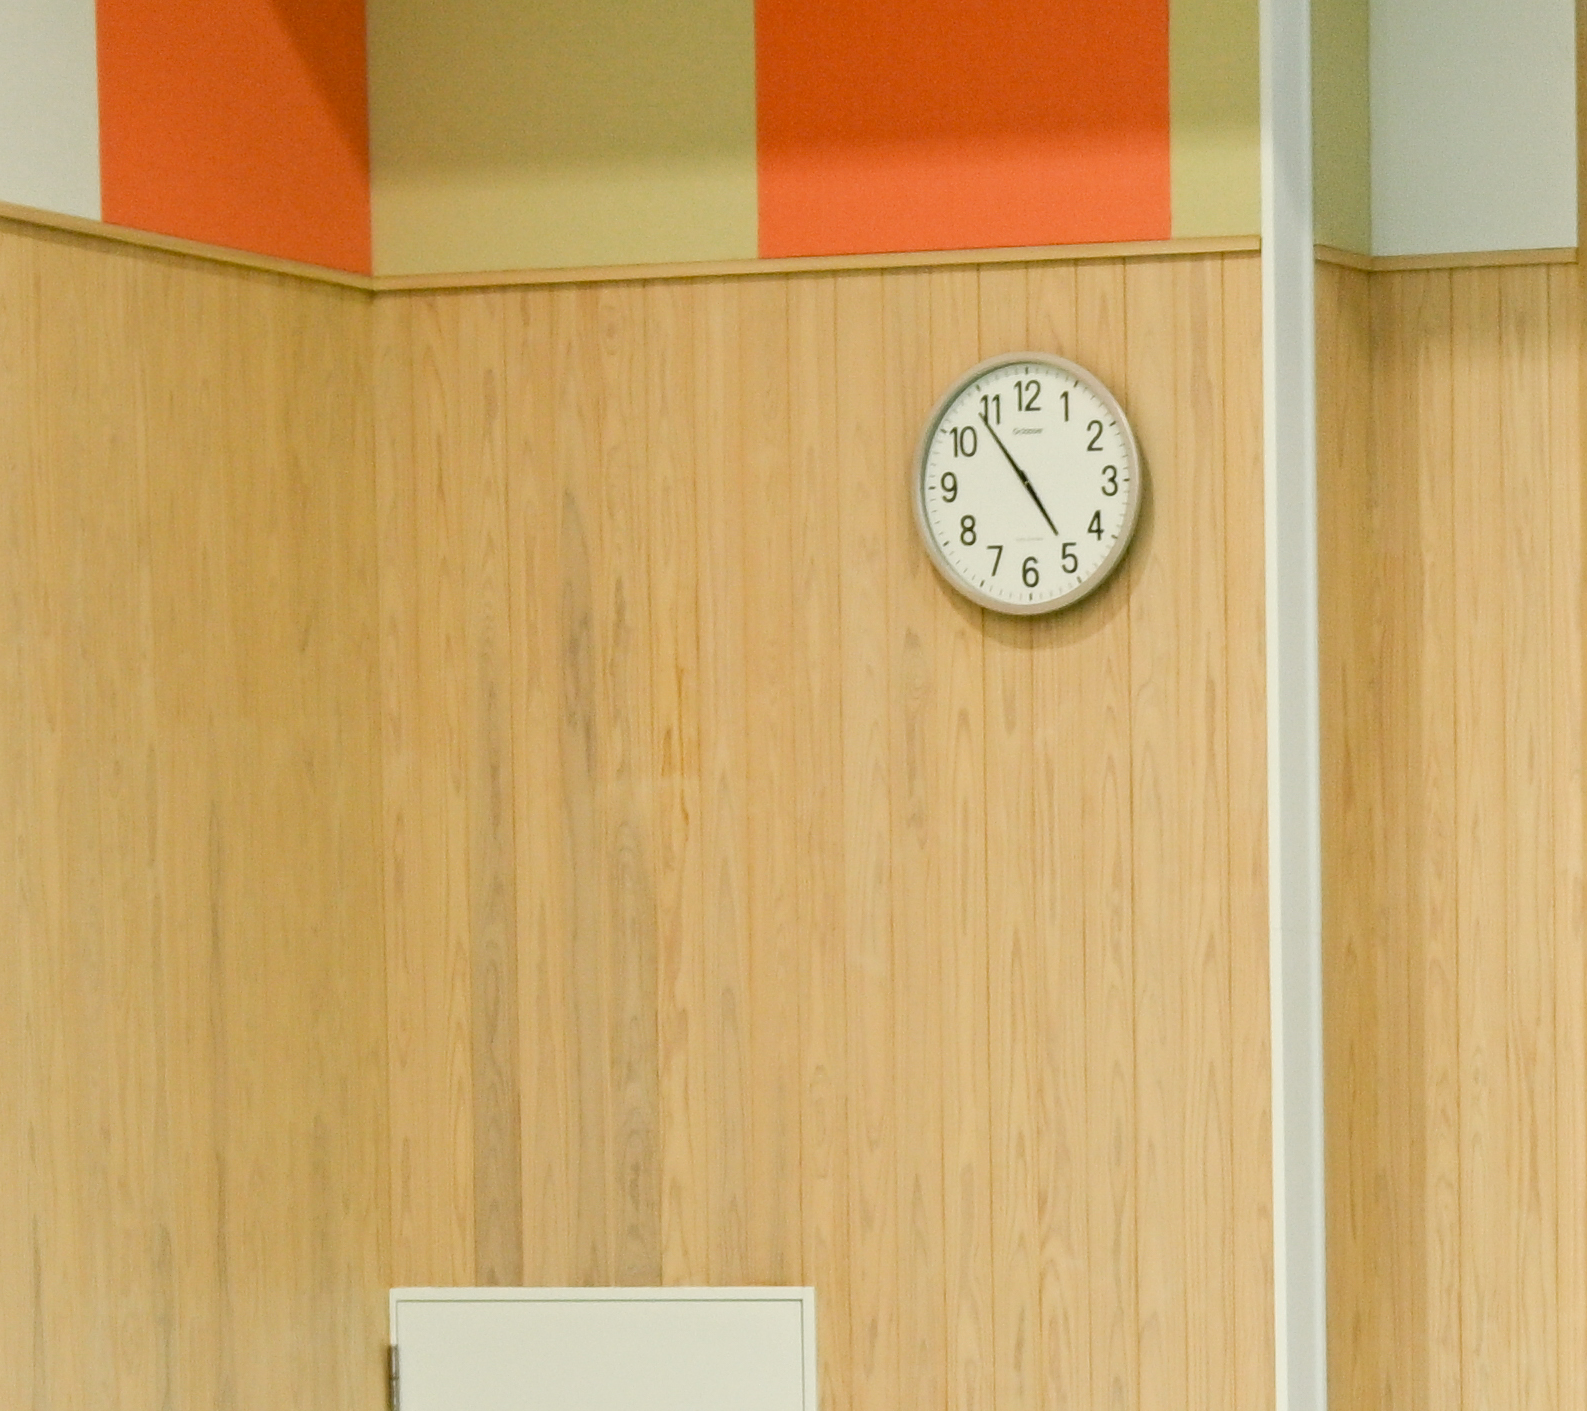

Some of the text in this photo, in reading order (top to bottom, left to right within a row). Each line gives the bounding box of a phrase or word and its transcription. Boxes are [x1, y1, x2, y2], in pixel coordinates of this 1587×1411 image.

[980, 393, 1001, 425] 11
[1013, 380, 1041, 411] 12
[1060, 391, 1069, 422] 1
[949, 426, 977, 457] 10
[1087, 420, 1103, 451] 2
[940, 471, 958, 502] 9
[1101, 465, 1118, 496] 3
[960, 515, 976, 545] 8
[1087, 510, 1104, 540] 4
[986, 545, 1003, 576] 7
[1022, 556, 1039, 587] 6
[1061, 542, 1078, 573] 5
